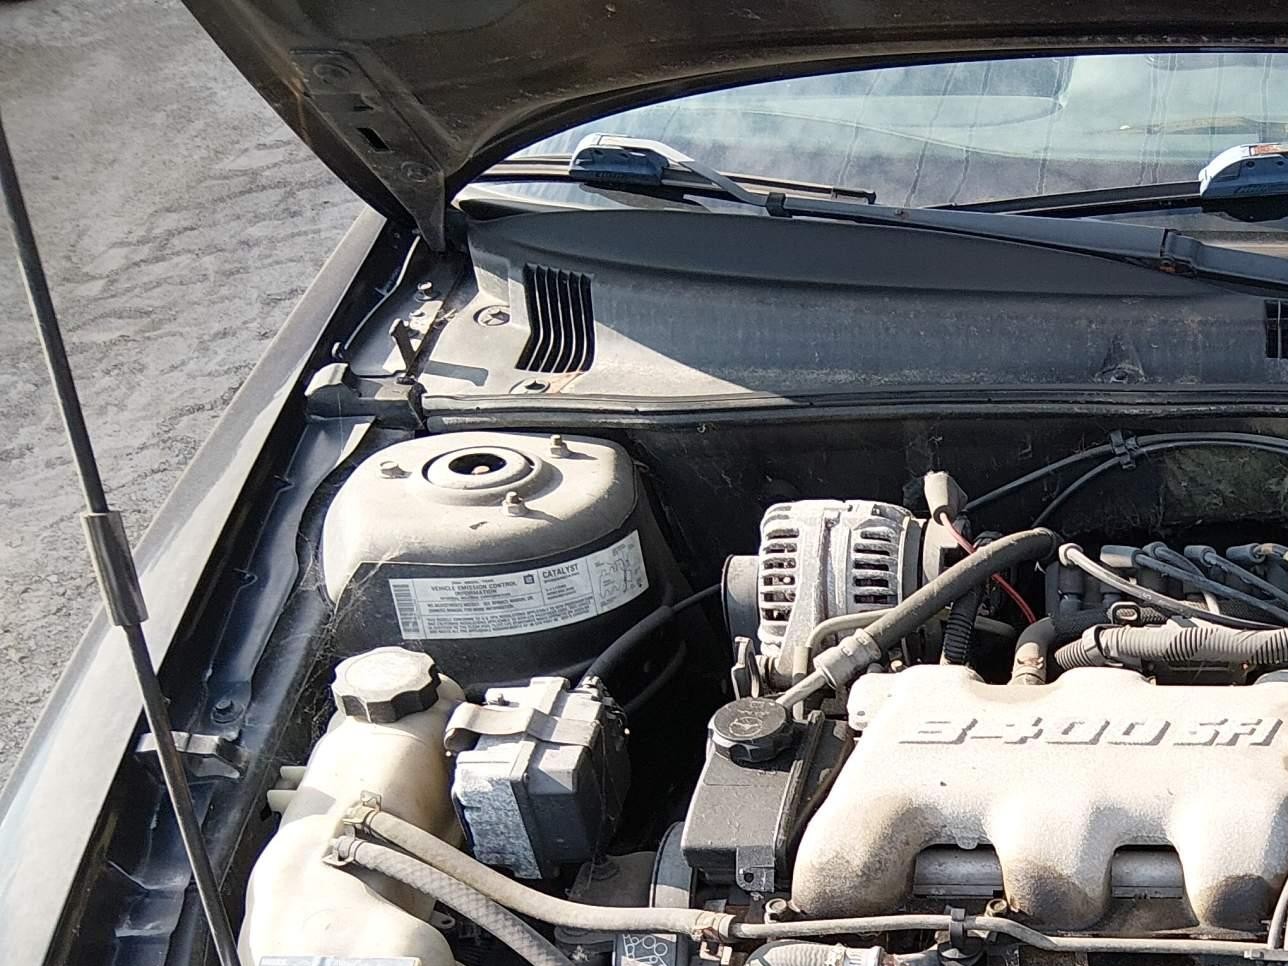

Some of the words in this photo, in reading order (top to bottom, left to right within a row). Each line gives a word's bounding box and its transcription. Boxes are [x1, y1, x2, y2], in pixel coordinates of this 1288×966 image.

[542, 563, 578, 579] CATALYST
[457, 583, 487, 591] EMISSION
[489, 581, 517, 589] CONTROL
[899, 717, 1171, 746] 3400
[1173, 717, 1284, 746] SFI
